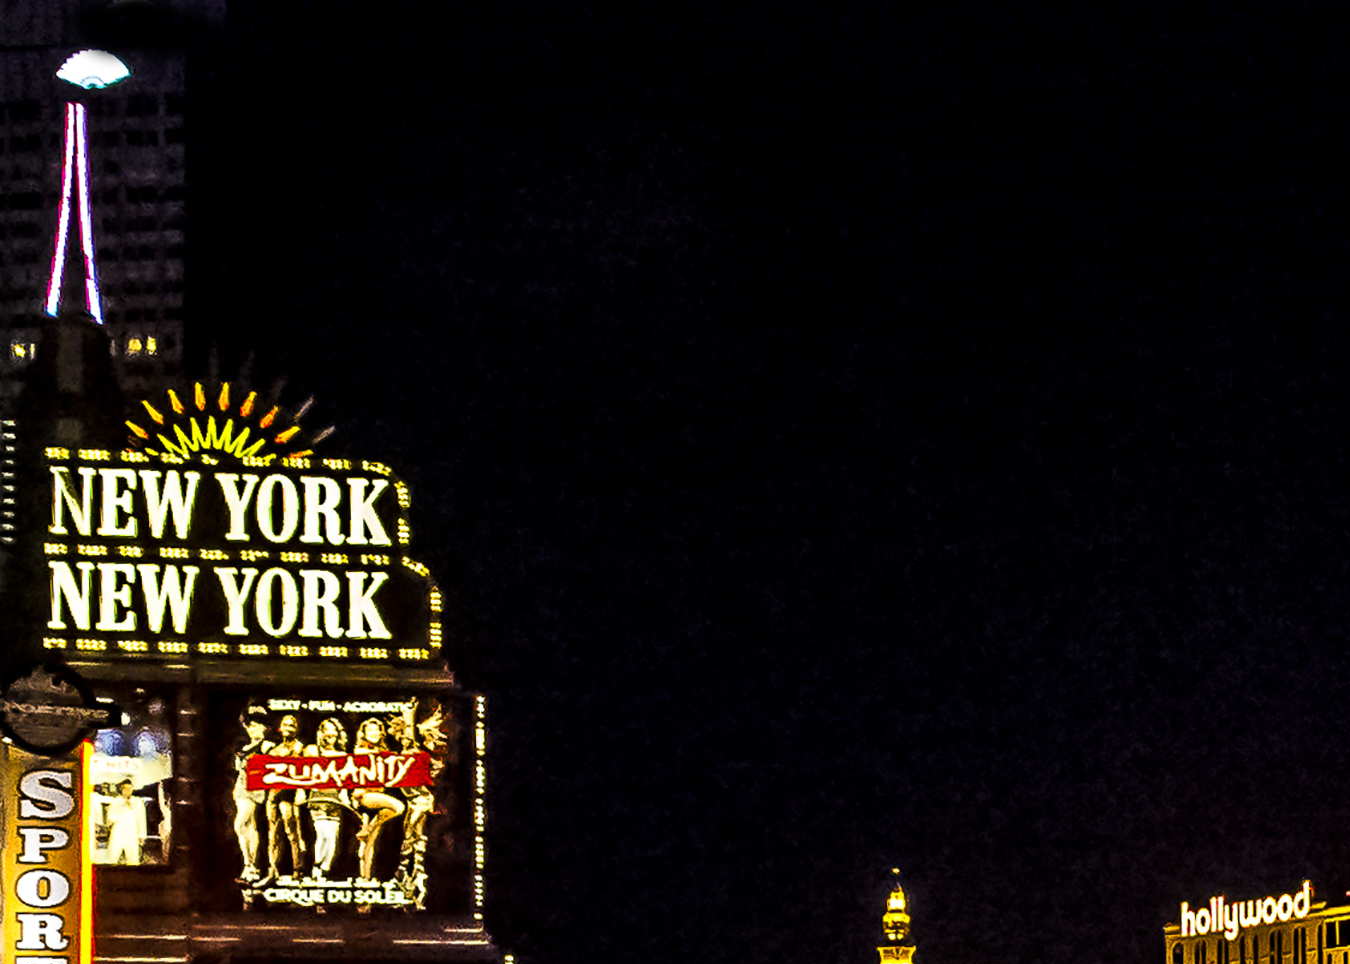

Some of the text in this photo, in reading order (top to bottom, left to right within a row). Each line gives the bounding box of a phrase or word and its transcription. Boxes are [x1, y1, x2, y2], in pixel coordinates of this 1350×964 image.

[49, 466, 392, 546] NEW YORK
[47, 560, 392, 640] NEW YORK
[262, 753, 416, 787] ZUMANITY
[263, 888, 326, 907] CIRQUE
[326, 889, 353, 903] DU
[1181, 879, 1312, 941] hollywood
